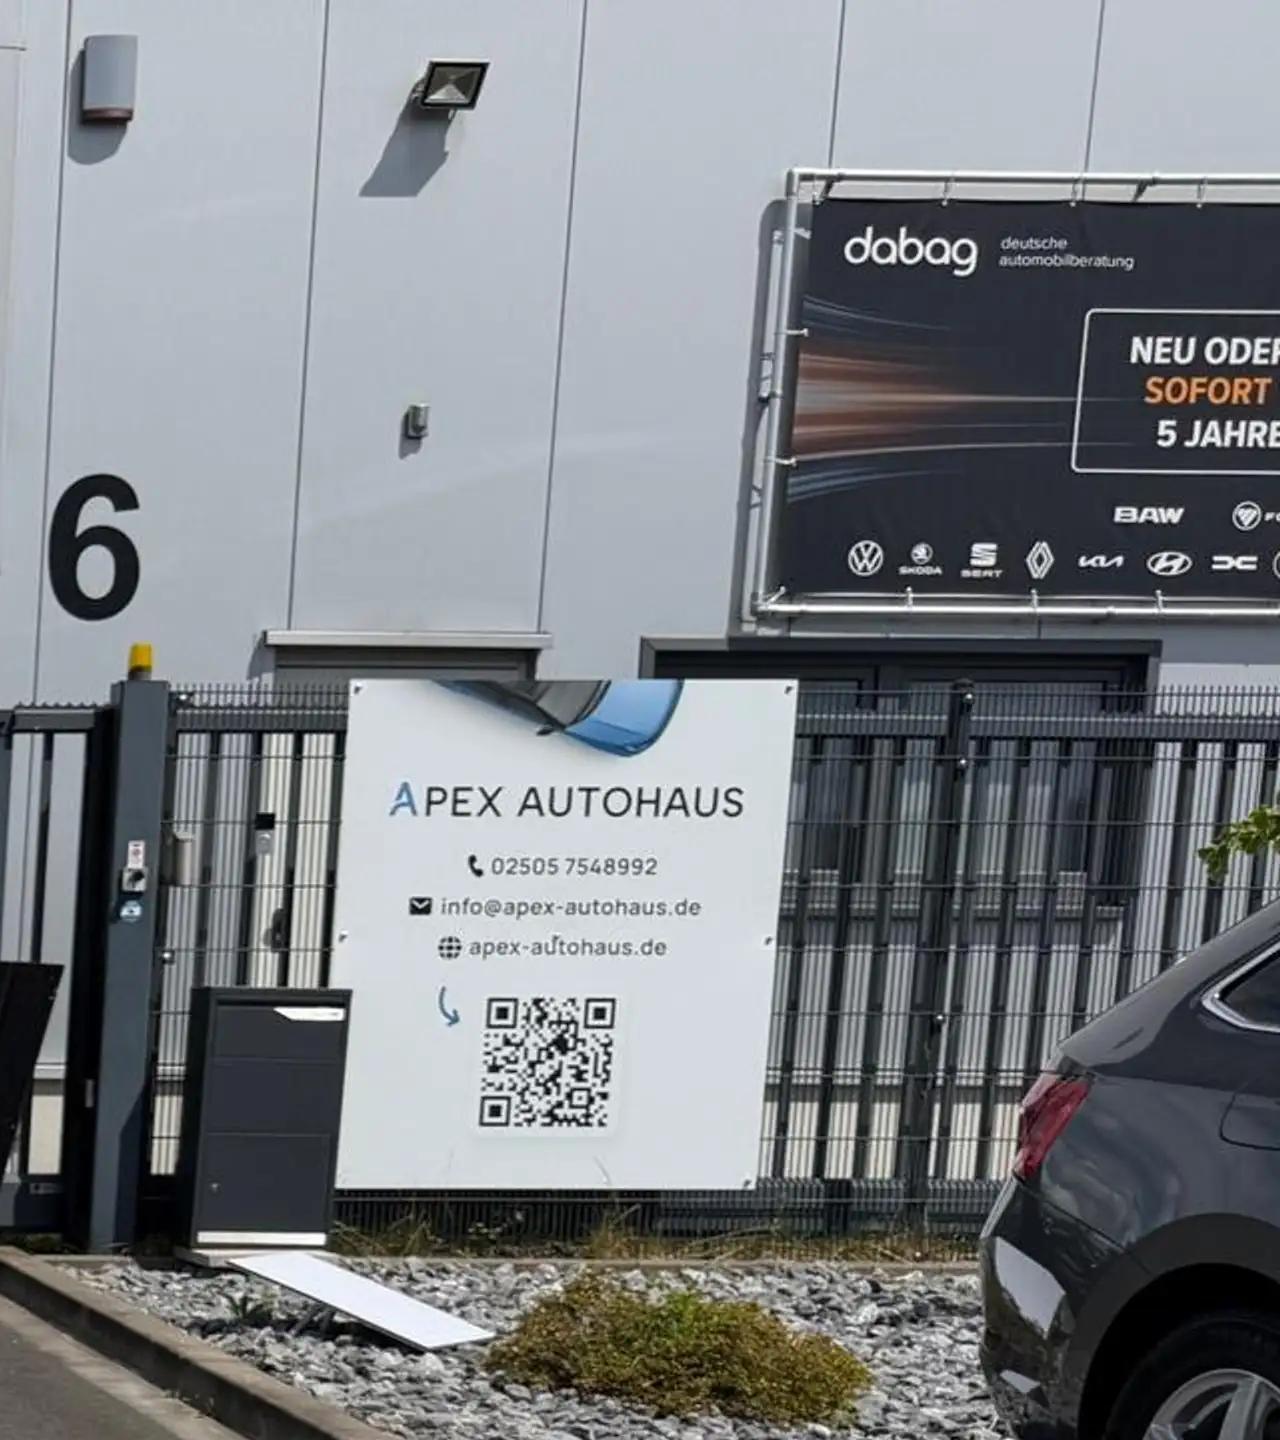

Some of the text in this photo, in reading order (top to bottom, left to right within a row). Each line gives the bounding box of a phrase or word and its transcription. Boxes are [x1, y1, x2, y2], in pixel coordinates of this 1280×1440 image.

[844, 226, 979, 276] dabag
[1001, 236, 1068, 250] deutsche
[999, 253, 1135, 271] automobilberatung
[1130, 336, 1197, 365] NEU
[1144, 376, 1272, 404] SOFORT
[1156, 419, 1177, 447] 5
[1114, 506, 1185, 524] BAW
[47, 473, 141, 621] 6
[389, 782, 745, 817] APEX AUTOHAUS
[491, 858, 657, 876] 02505 7548992
[440, 898, 702, 921] info@apex-autohaus.de
[469, 938, 667, 958] apex-autohaus.de
